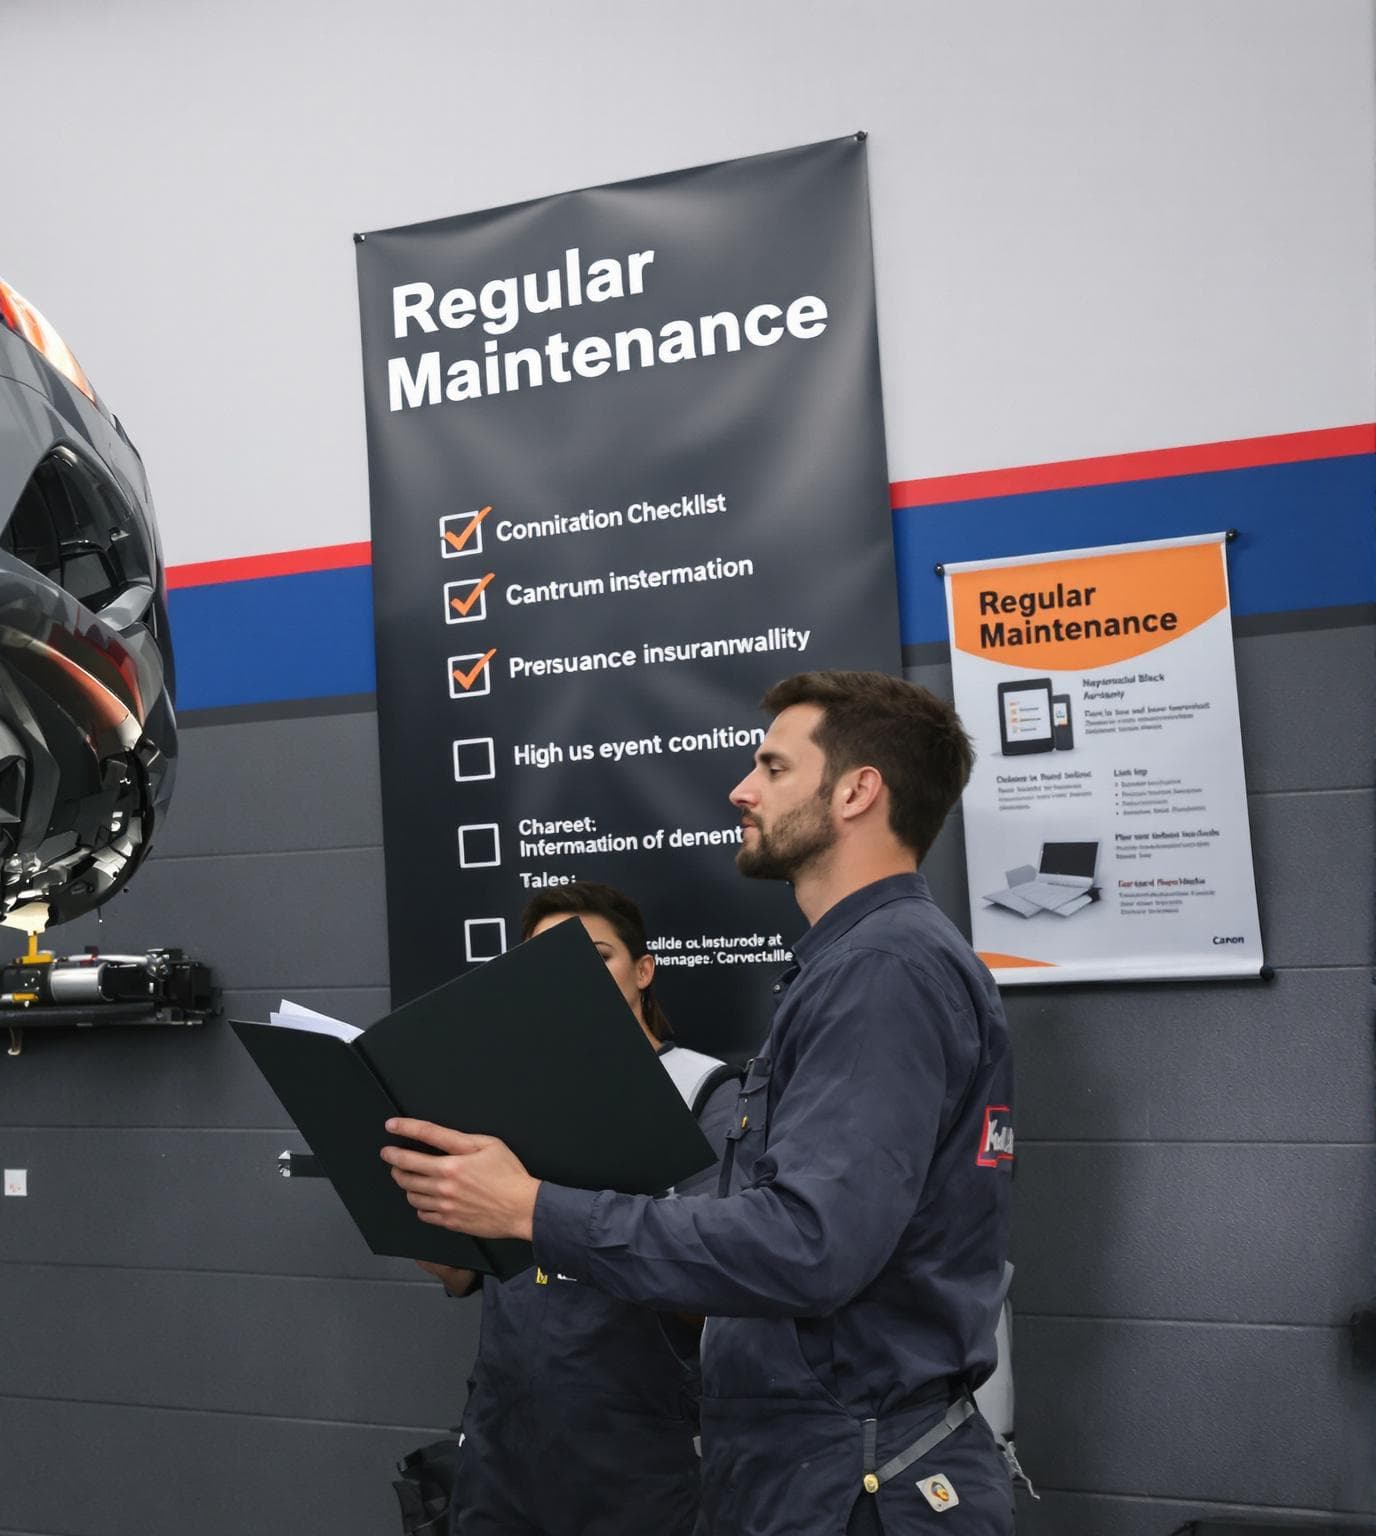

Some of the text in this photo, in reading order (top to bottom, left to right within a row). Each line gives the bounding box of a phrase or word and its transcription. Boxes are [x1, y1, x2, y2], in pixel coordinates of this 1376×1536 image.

[392, 248, 655, 338] Regular
[387, 295, 828, 412] Maintenance
[506, 557, 754, 605] Cantrum instermation
[979, 583, 1096, 617] Regular
[980, 610, 1178, 649] Maintenance
[514, 742, 563, 768] High
[569, 745, 595, 762] us
[599, 735, 663, 761] eyent
[642, 829, 665, 849] of
[1212, 936, 1245, 945] Canon
